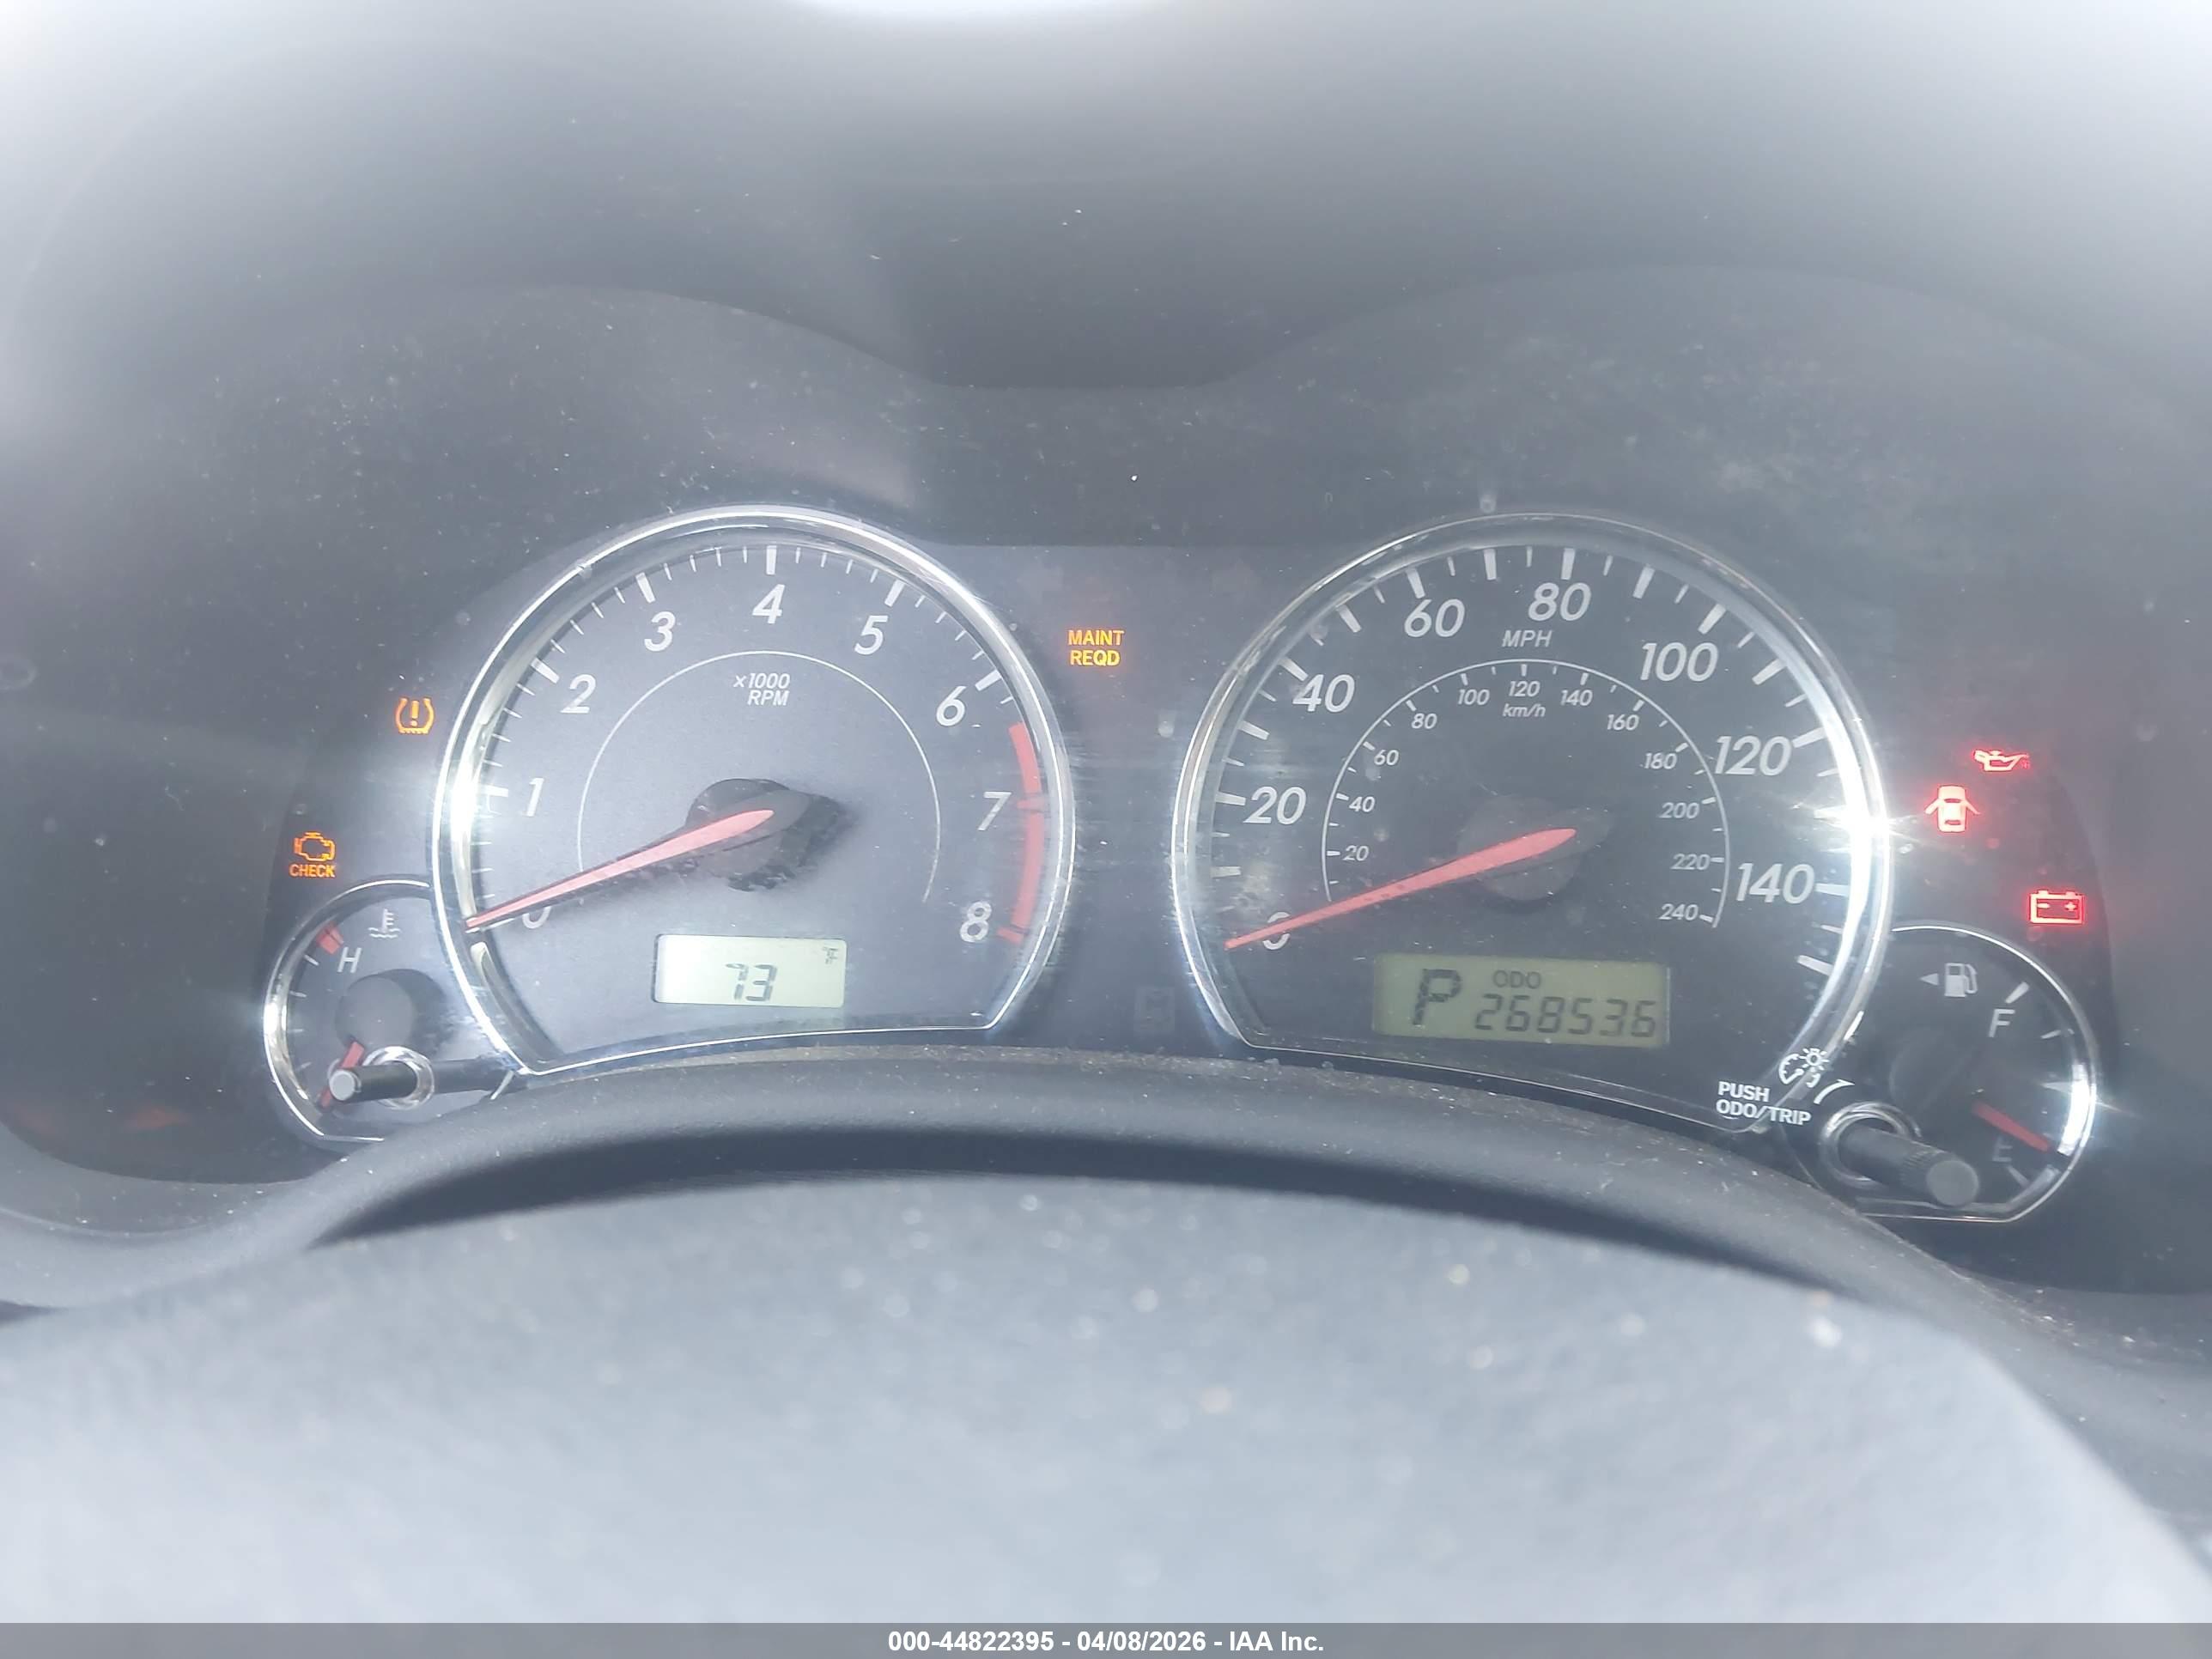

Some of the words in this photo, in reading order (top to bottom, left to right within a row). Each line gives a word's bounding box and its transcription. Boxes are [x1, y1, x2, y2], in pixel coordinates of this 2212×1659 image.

[752, 584, 785, 623] 4
[1528, 582, 1591, 621] 80
[644, 611, 675, 651] 3
[1404, 599, 1465, 637] 60
[854, 616, 888, 654] 5
[1067, 629, 1124, 647] MAINT
[1502, 629, 1553, 647] MPH
[1070, 650, 1121, 666] REQD
[1640, 642, 1717, 682] 100
[561, 674, 596, 714] 2
[747, 690, 789, 706] RPM
[1293, 674, 1355, 713] 40
[1457, 689, 1490, 706] 100
[1509, 681, 1540, 697] 120
[1560, 690, 1593, 707] 140
[935, 685, 966, 726] 6
[1503, 703, 1546, 719] km/h
[1411, 713, 1437, 730] 80
[1607, 714, 1639, 731] 160
[1375, 750, 1399, 766] 60
[1644, 752, 1677, 769] 180
[1715, 735, 1791, 776] 120
[526, 778, 544, 817] 1
[977, 791, 1012, 830] 7
[1243, 786, 1307, 825] 20
[1349, 796, 1376, 812] 40
[1658, 803, 1699, 819] 200
[1342, 845, 1370, 861] 20
[1670, 854, 1711, 871] 220
[289, 863, 336, 878] CHECK
[1736, 862, 1814, 904] 140
[959, 901, 992, 943] 8
[1658, 903, 1698, 921] 240
[337, 946, 362, 974] H
[726, 962, 777, 1002] 73
[1492, 971, 1542, 989] ODO
[1413, 968, 1462, 1026] P
[1474, 993, 1657, 1038] 268536
[1988, 1008, 2015, 1038] F
[1717, 1081, 1770, 1103] PUSH
[1716, 1099, 1812, 1126] ODO/TRIP
[1992, 1137, 2013, 1163] E
